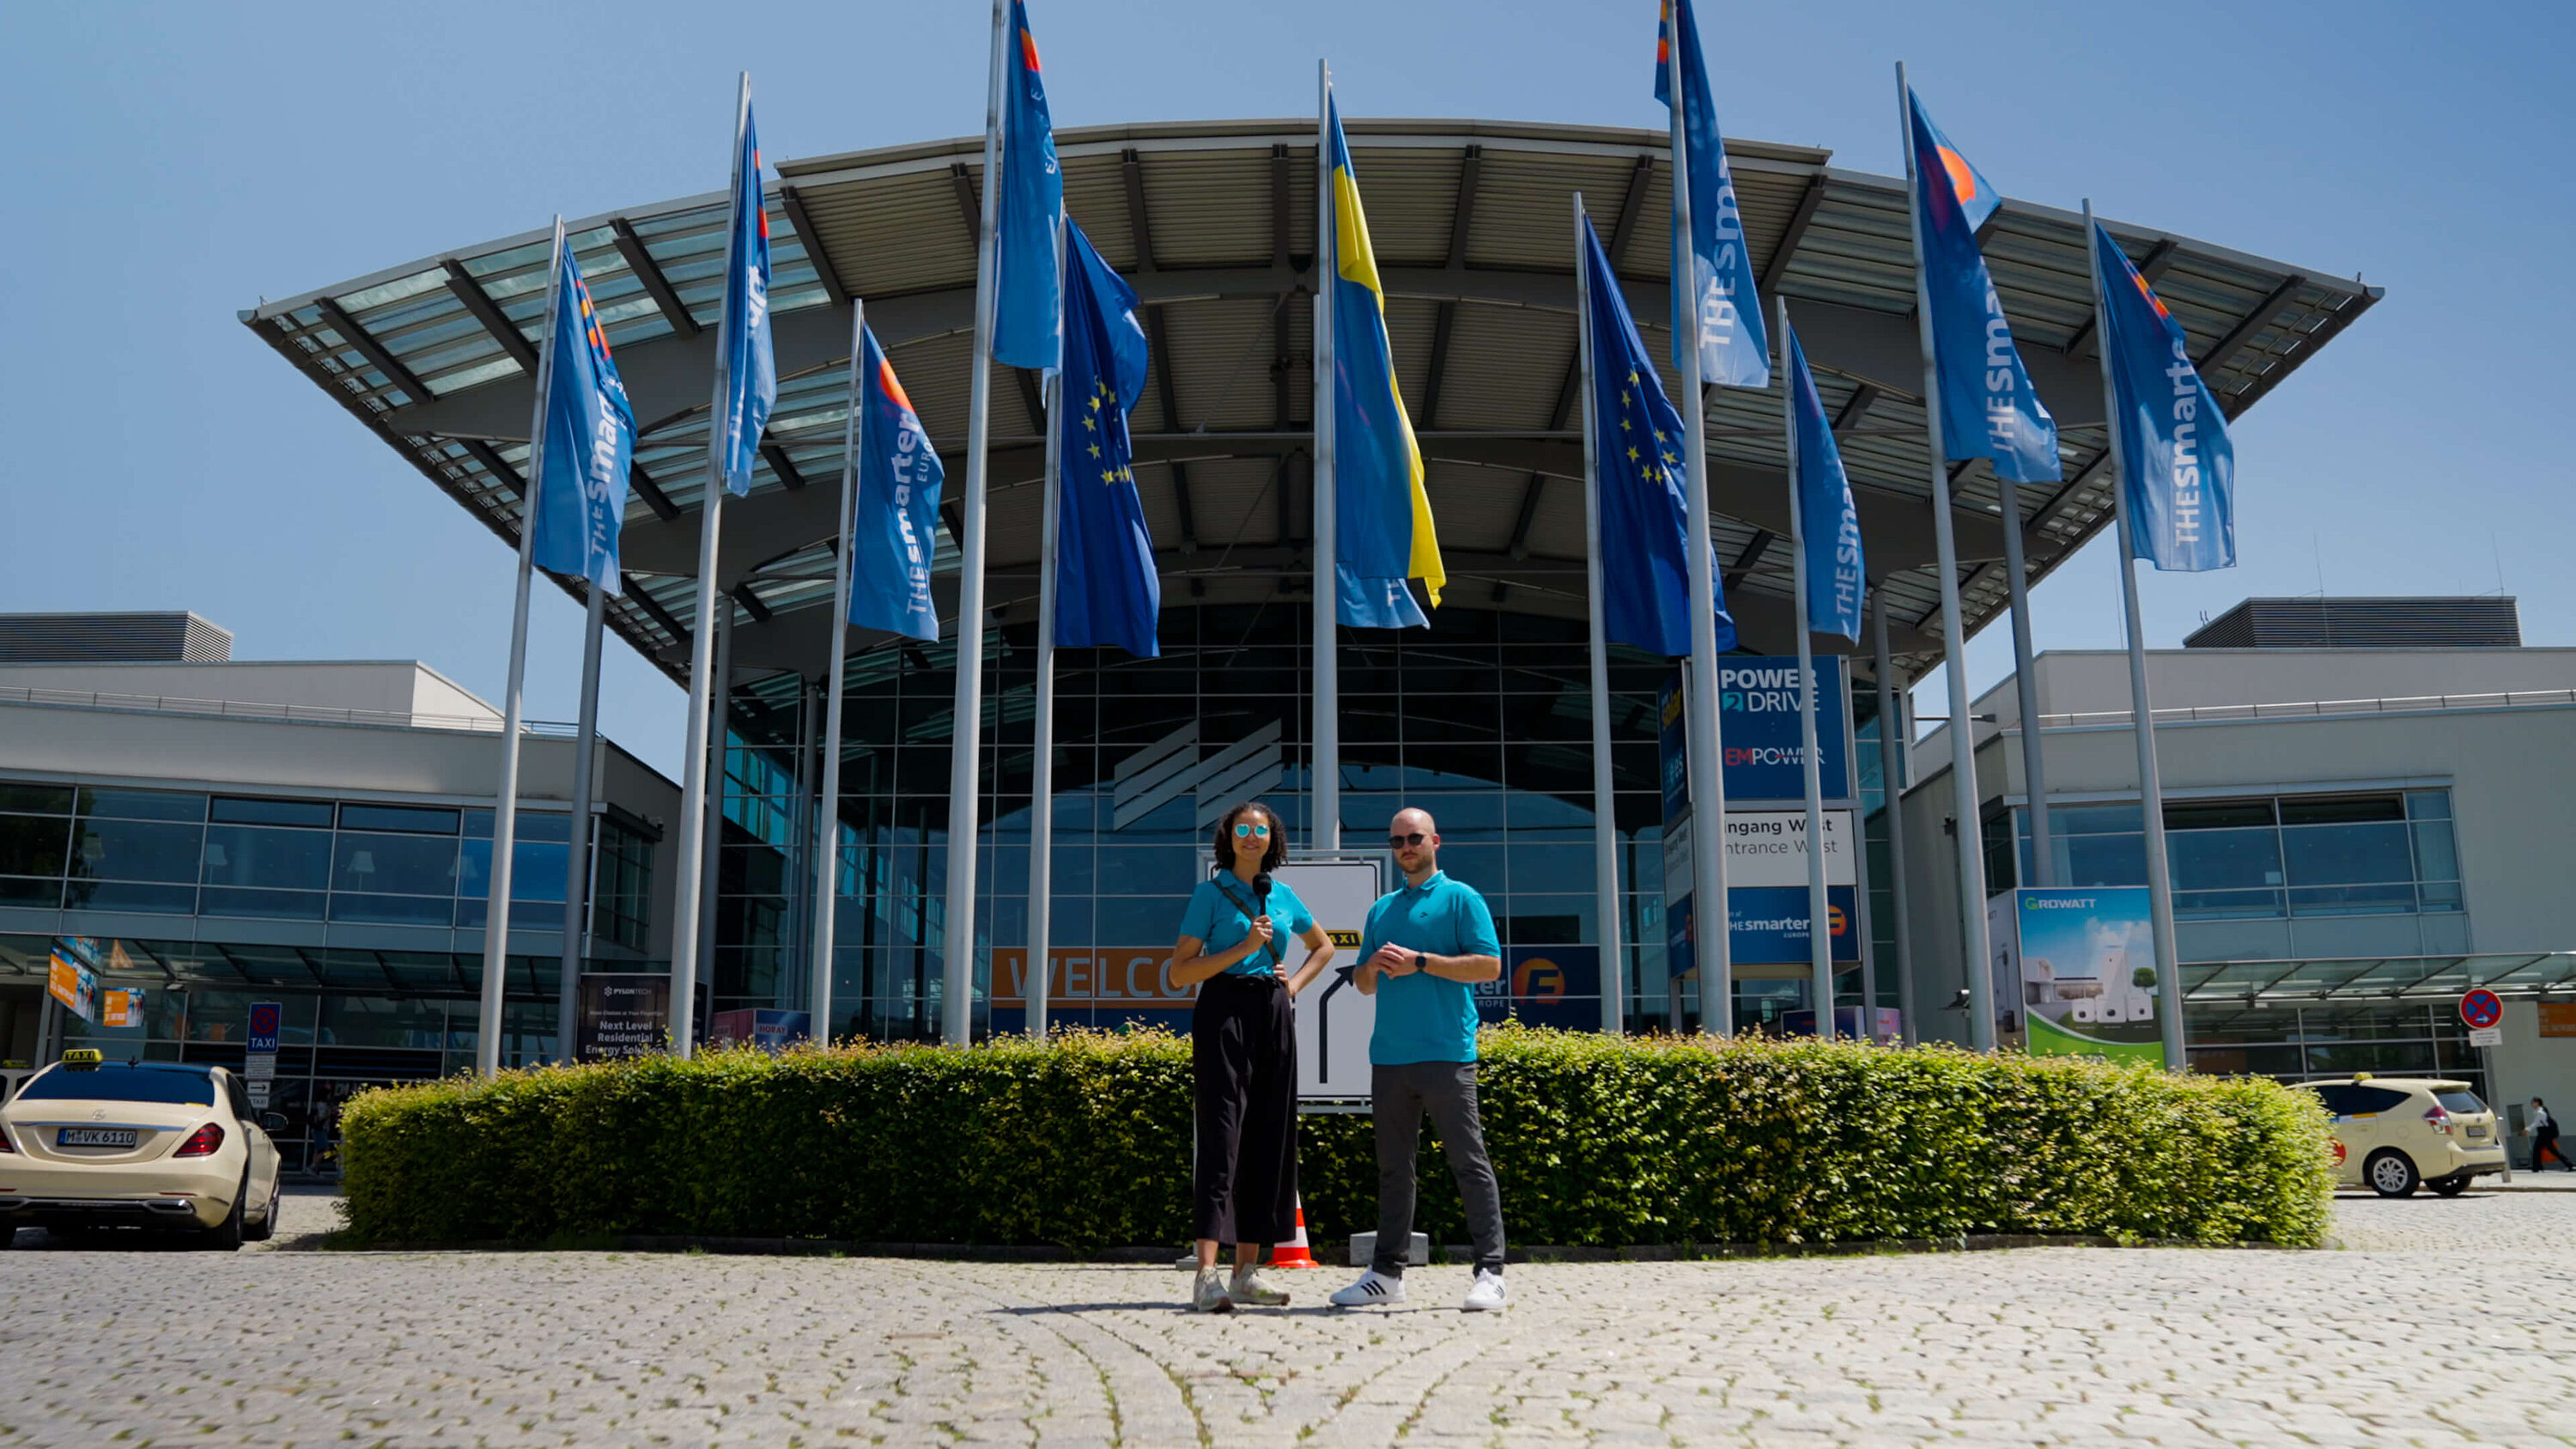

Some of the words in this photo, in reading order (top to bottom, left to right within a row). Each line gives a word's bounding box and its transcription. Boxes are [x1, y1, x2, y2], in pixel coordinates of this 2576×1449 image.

[1699, 157, 1740, 350] THEsm
[2166, 341, 2199, 546] THEsmart
[916, 441, 933, 482] EURO
[1726, 693, 1741, 711] 2
[1725, 747, 1826, 766] EMPOWR
[1725, 820, 1782, 836] ngang
[1789, 819, 1832, 832] Wt
[1726, 841, 1788, 854] ntrance
[1794, 838, 1838, 853] Wst
[2026, 897, 2096, 910] GROWATT
[1729, 917, 1810, 931] HEsmarter
[1329, 934, 1356, 944] AXI
[1009, 956, 1192, 997] WELCO
[599, 1020, 623, 1031] Next
[626, 1020, 653, 1031] Level
[250, 1038, 276, 1049] TAXI
[598, 1032, 653, 1043] Residential
[67, 1050, 94, 1061] TAXI
[586, 1044, 620, 1056] Enrgy
[66, 1132, 75, 1142] M
[84, 1132, 99, 1142] VK
[102, 1132, 134, 1143] 6110
